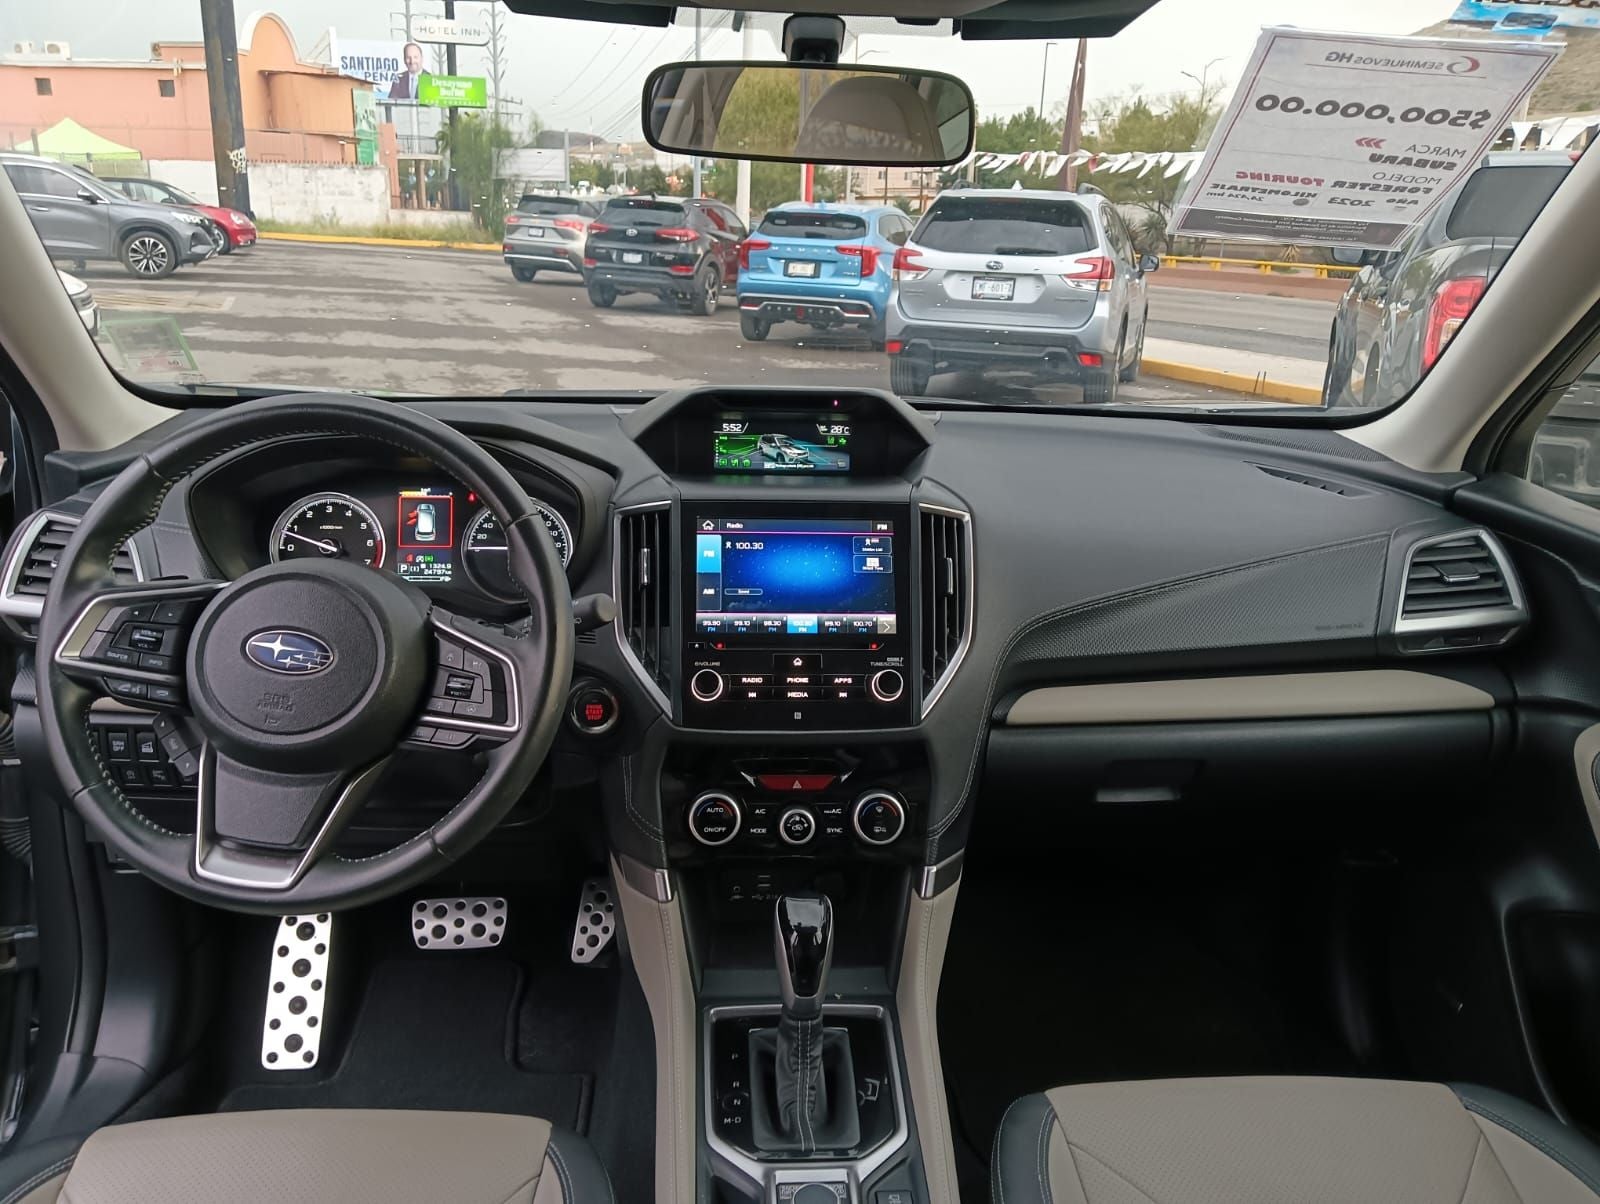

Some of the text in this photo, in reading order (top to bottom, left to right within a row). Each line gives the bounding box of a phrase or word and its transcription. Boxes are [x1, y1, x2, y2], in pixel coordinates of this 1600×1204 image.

[340, 55, 399, 72] SANTIAGO
[326, 505, 333, 513] 3
[287, 544, 295, 552] 0
[735, 541, 764, 550] 100.30
